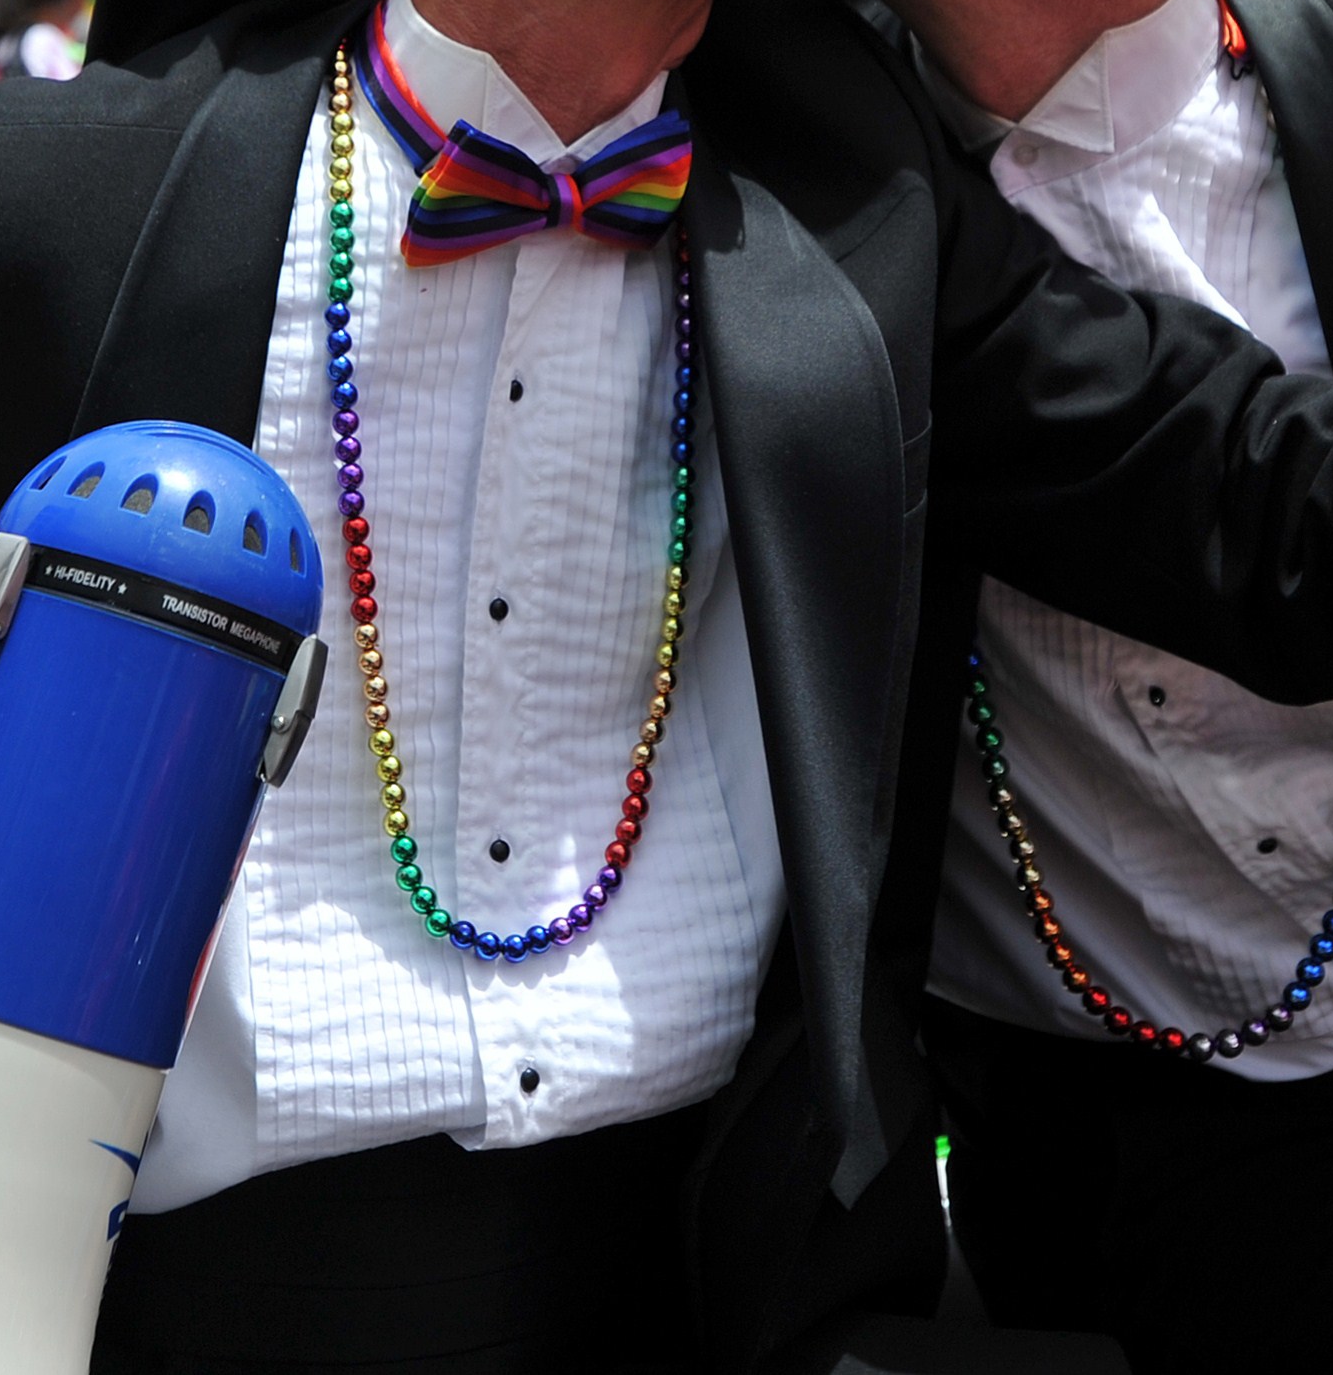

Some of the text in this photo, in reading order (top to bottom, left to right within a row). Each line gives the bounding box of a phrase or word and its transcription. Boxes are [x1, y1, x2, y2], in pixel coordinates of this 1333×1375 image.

[54, 564, 117, 592] HI-FIDELITY
[161, 593, 282, 655] TRANSISTOR MEGAPHONE
